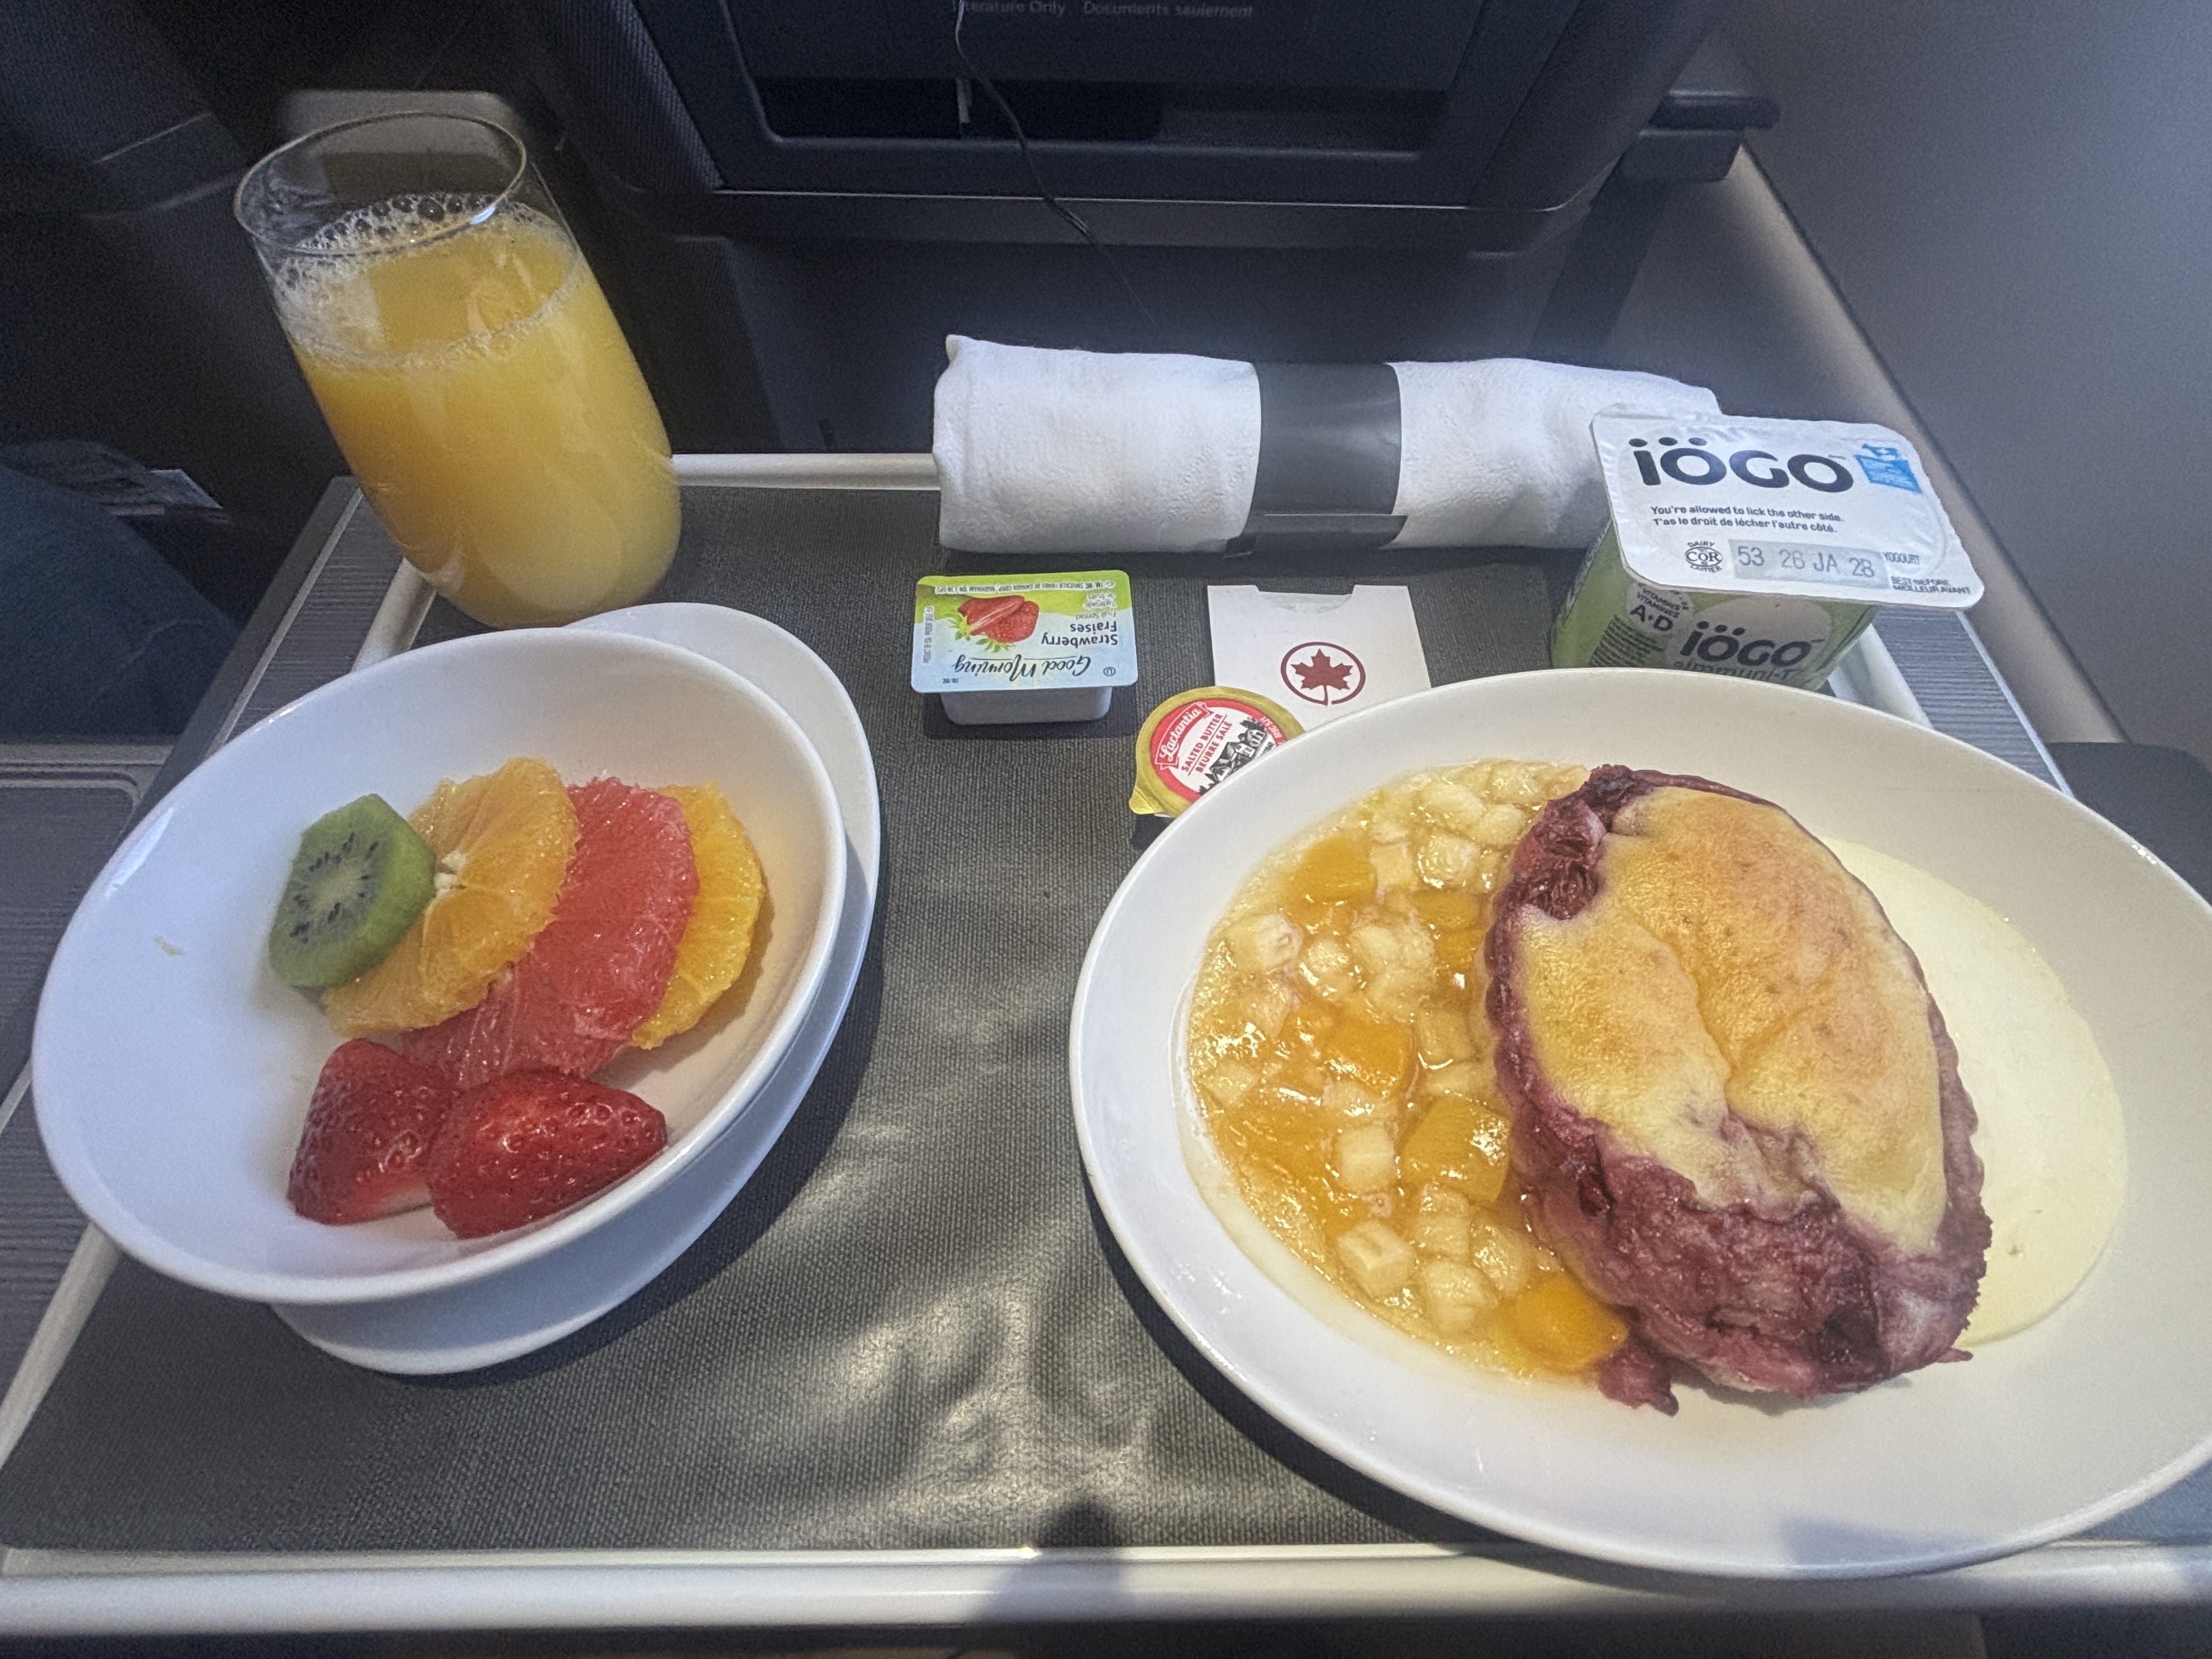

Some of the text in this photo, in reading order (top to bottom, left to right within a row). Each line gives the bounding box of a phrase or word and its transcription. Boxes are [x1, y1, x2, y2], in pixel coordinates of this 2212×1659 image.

[1029, 1, 1065, 17] Only
[1084, 1, 1169, 15] Documents
[1175, 3, 1253, 18] seulement
[1651, 505, 1844, 522] You're allowed to lick the other side.
[1678, 517, 1689, 525] le
[1691, 517, 1718, 526] droit
[1735, 517, 1770, 528] lécher
[1772, 520, 1809, 530] l'autre
[1810, 523, 1837, 533] côté.
[1737, 545, 1875, 578] 53 26 JA 28
[1882, 552, 1920, 565] YOGOURT
[1891, 576, 1950, 586] BEST BEFORE
[1892, 584, 1971, 595] MEILLEUR AVANT
[1076, 612, 1099, 620] Spread
[1070, 620, 1117, 635] Fraises
[1041, 632, 1118, 648] Strawberry
[952, 653, 1091, 681] Good Morning
[1159, 708, 1203, 762] Lactantia
[1181, 714, 1223, 772] SALTED BUTTER
[1195, 741, 1220, 772] BEURRE
